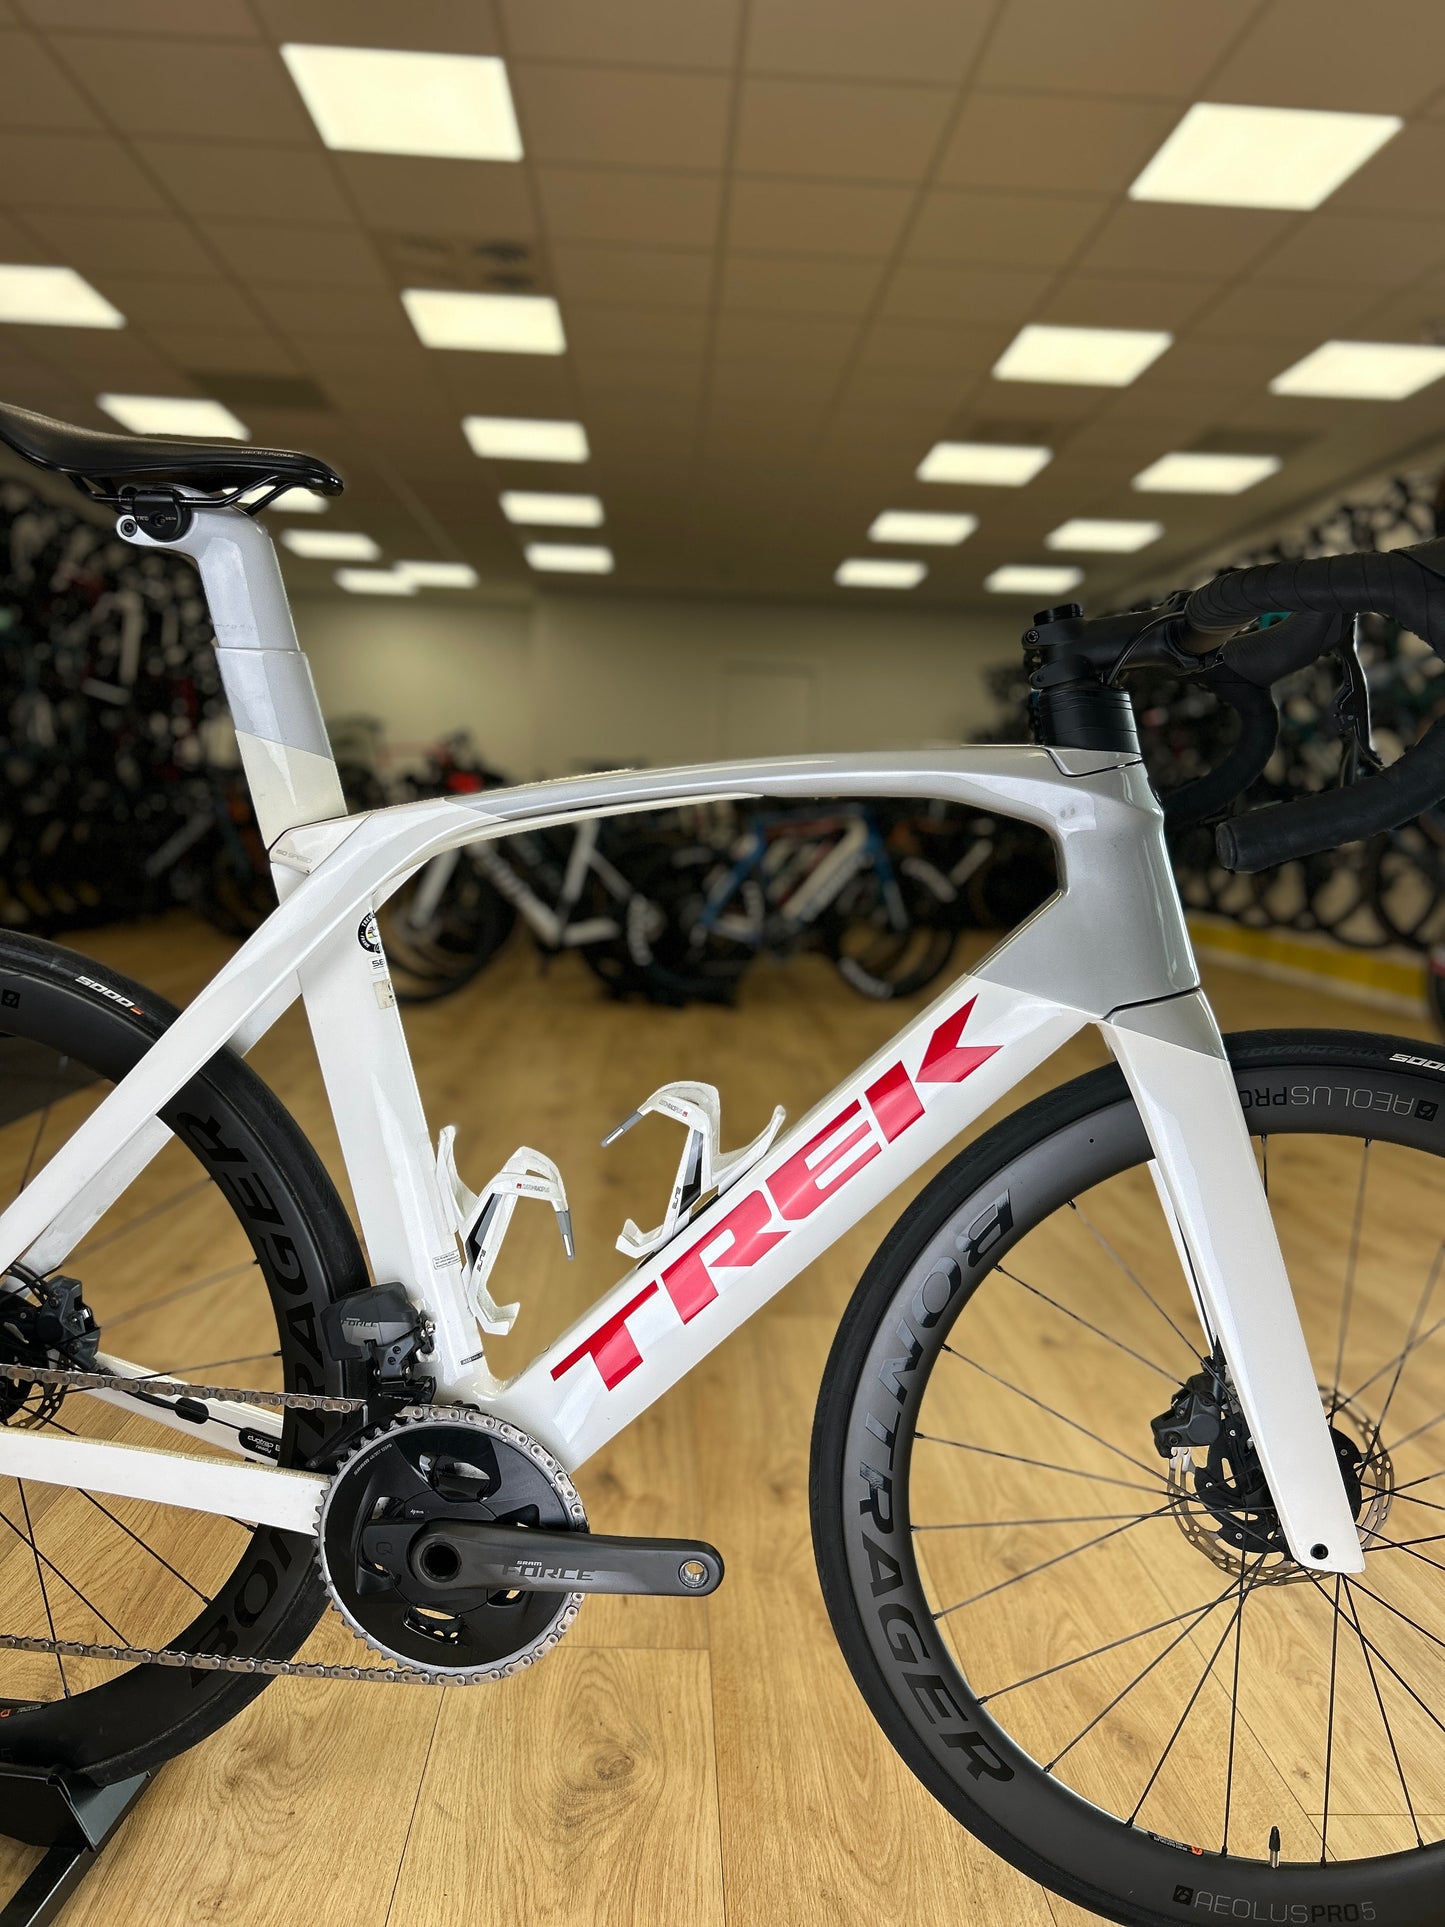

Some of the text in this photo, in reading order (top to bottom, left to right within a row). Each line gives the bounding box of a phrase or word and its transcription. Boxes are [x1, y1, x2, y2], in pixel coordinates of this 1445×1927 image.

[75, 975, 136, 1008] 5000
[550, 993, 1005, 1392] TREK
[502, 1564, 594, 1581] FORCE
[859, 1188, 1016, 1782] BONTRAGER
